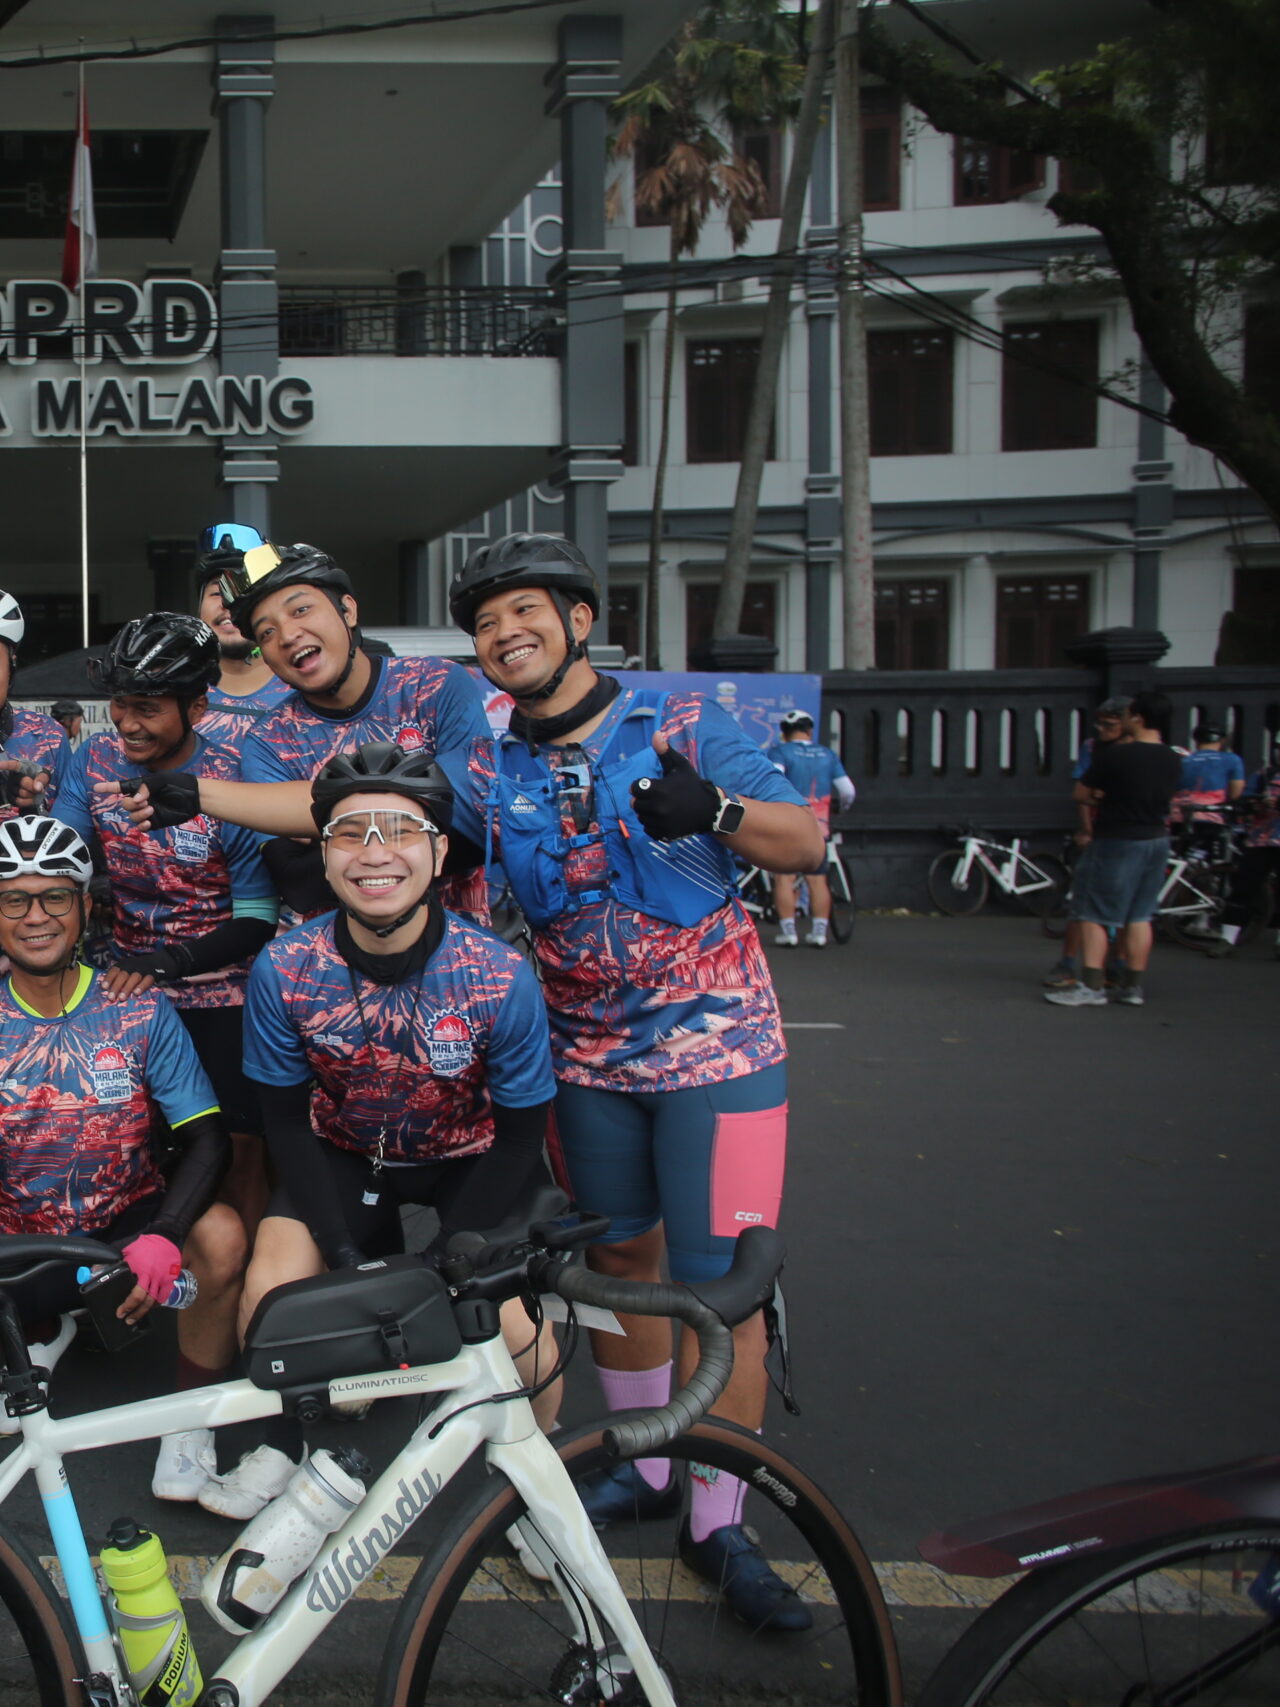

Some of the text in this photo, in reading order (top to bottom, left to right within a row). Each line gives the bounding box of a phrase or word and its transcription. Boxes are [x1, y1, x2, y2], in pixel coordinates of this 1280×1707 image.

[32, 375, 316, 437] MALANG
[176, 831, 208, 845] MALANG
[431, 1042, 471, 1054] MALANG
[95, 1070, 129, 1082] MALANG
[306, 1466, 442, 1615] Wdnsdy
[162, 1631, 192, 1692] PODIUM
